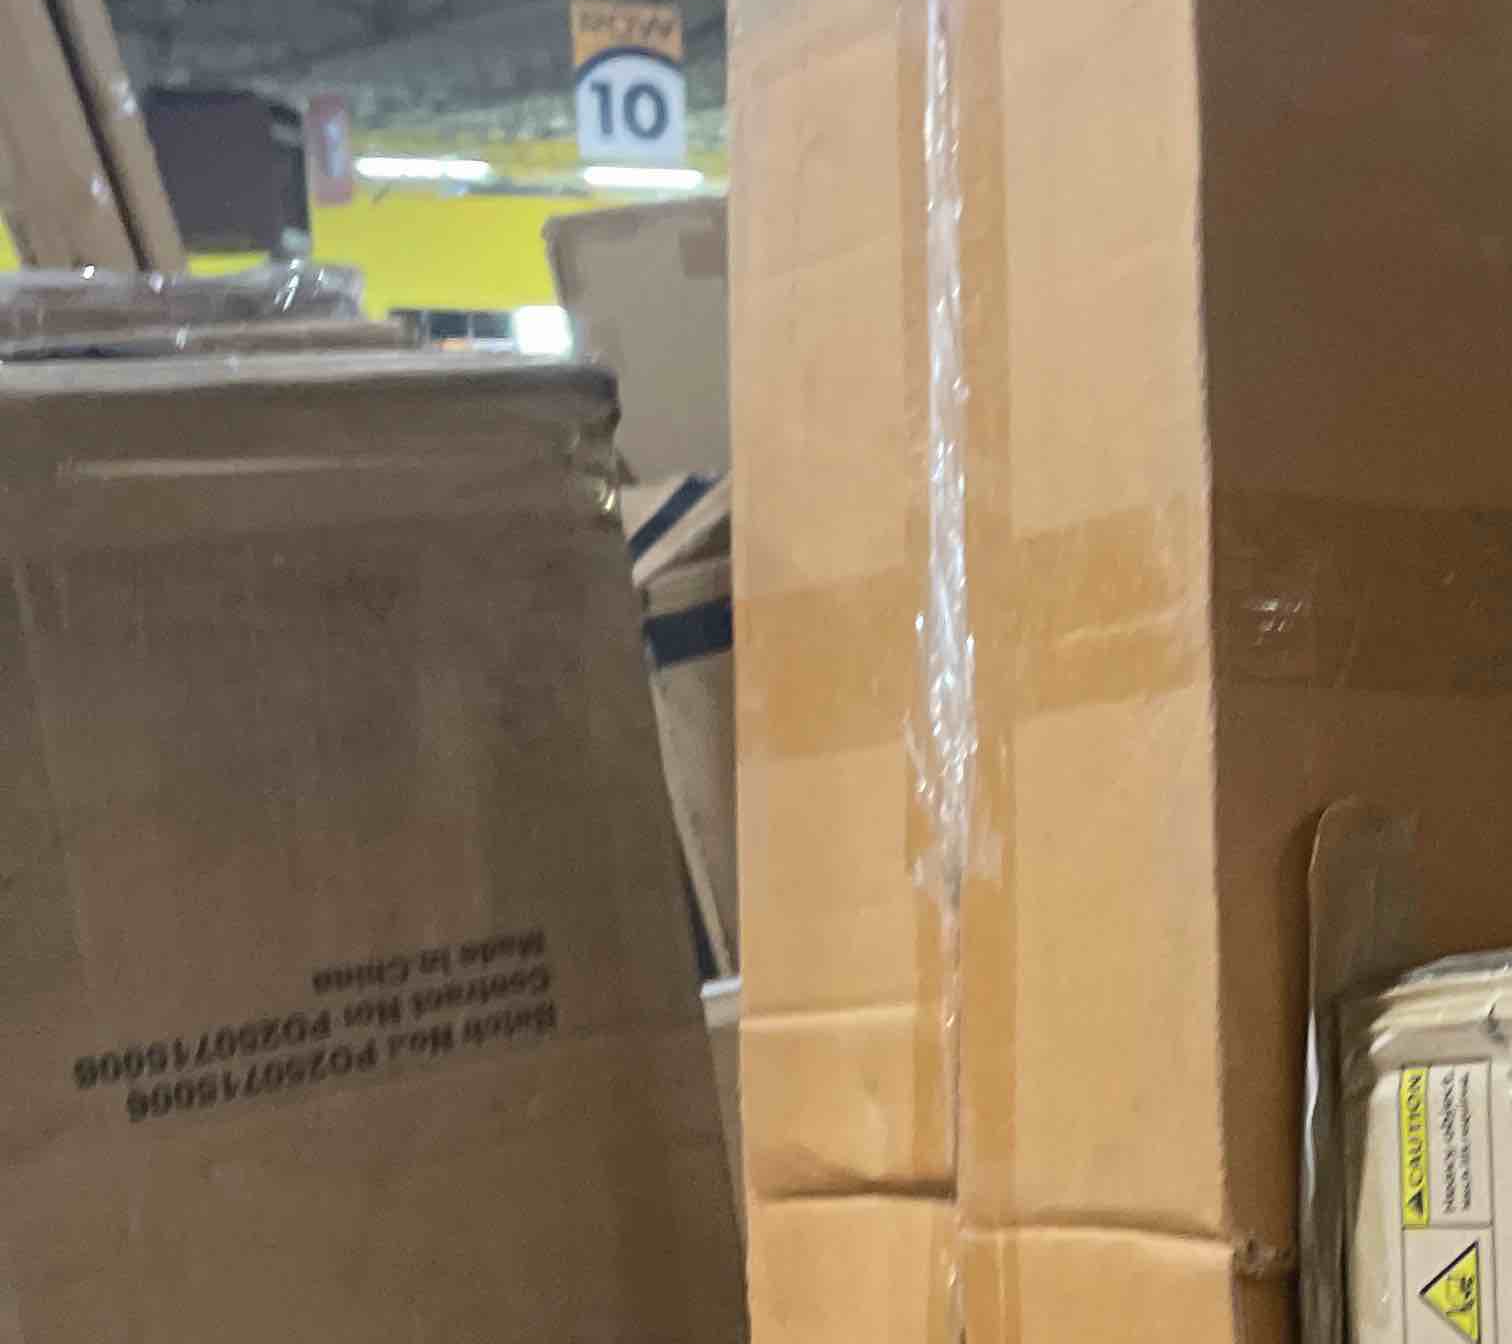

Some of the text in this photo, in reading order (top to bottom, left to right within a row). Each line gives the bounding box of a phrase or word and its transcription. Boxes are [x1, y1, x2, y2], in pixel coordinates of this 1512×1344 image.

[590, 81, 670, 140] 10
[461, 929, 546, 970] Made
[313, 960, 410, 997] China
[1407, 1074, 1424, 1187] CAUTION
